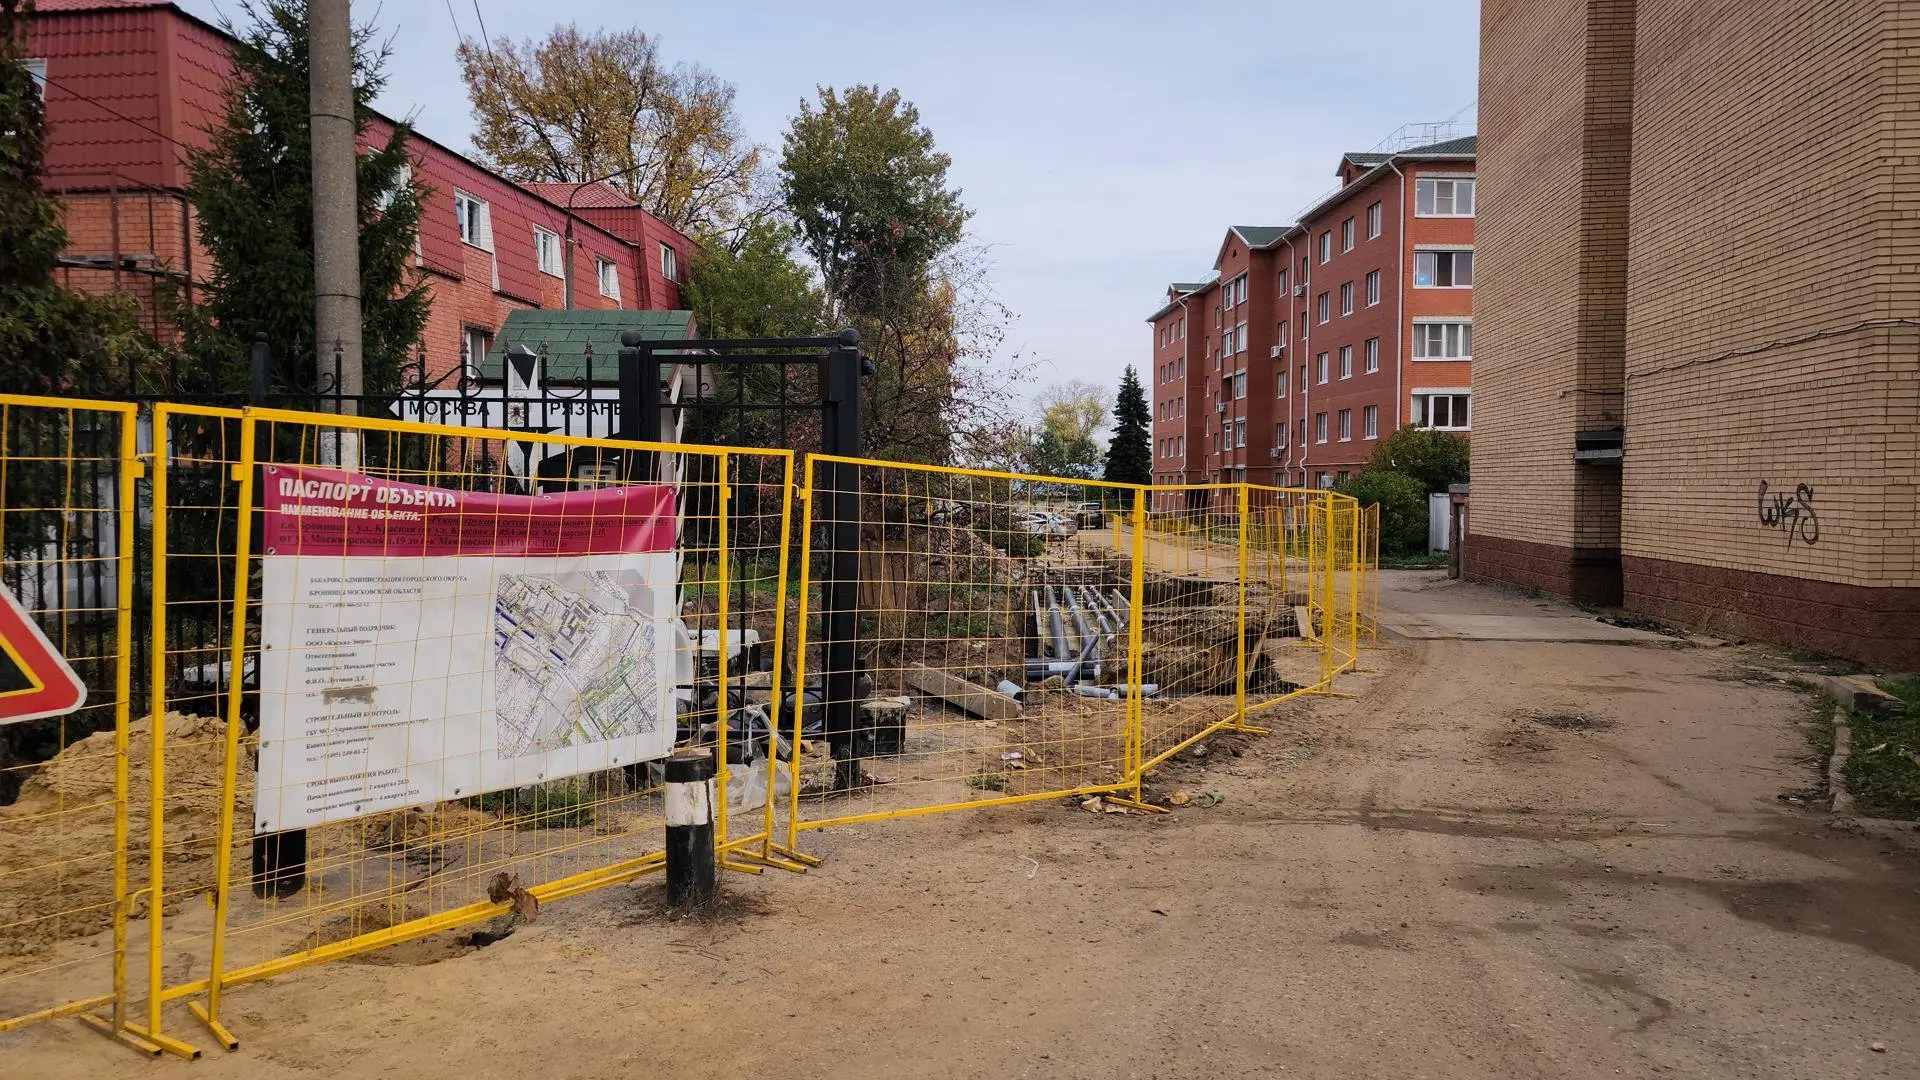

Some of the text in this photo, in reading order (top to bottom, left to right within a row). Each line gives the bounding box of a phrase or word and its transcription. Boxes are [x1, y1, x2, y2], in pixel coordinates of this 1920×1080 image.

[409, 401, 490, 416] МОСКВА
[279, 477, 457, 508] ПАСПОРТ ОБЪЕКТА
[280, 503, 369, 519] НАИМЕНОВАНИЕ
